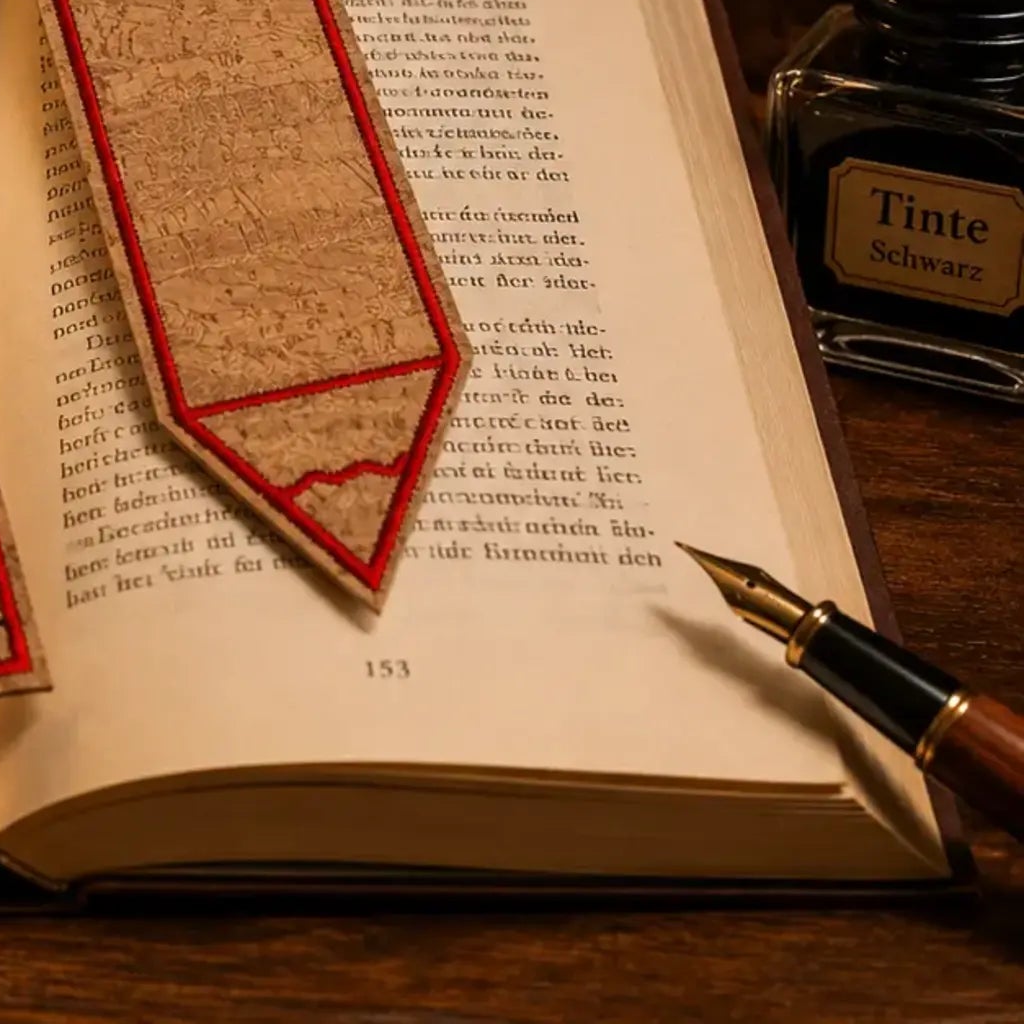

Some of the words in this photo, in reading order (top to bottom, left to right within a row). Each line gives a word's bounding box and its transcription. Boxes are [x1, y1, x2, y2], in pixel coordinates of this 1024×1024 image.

[871, 187, 989, 244] Tinte
[870, 239, 983, 282] Schwarz
[365, 659, 410, 679] 153
